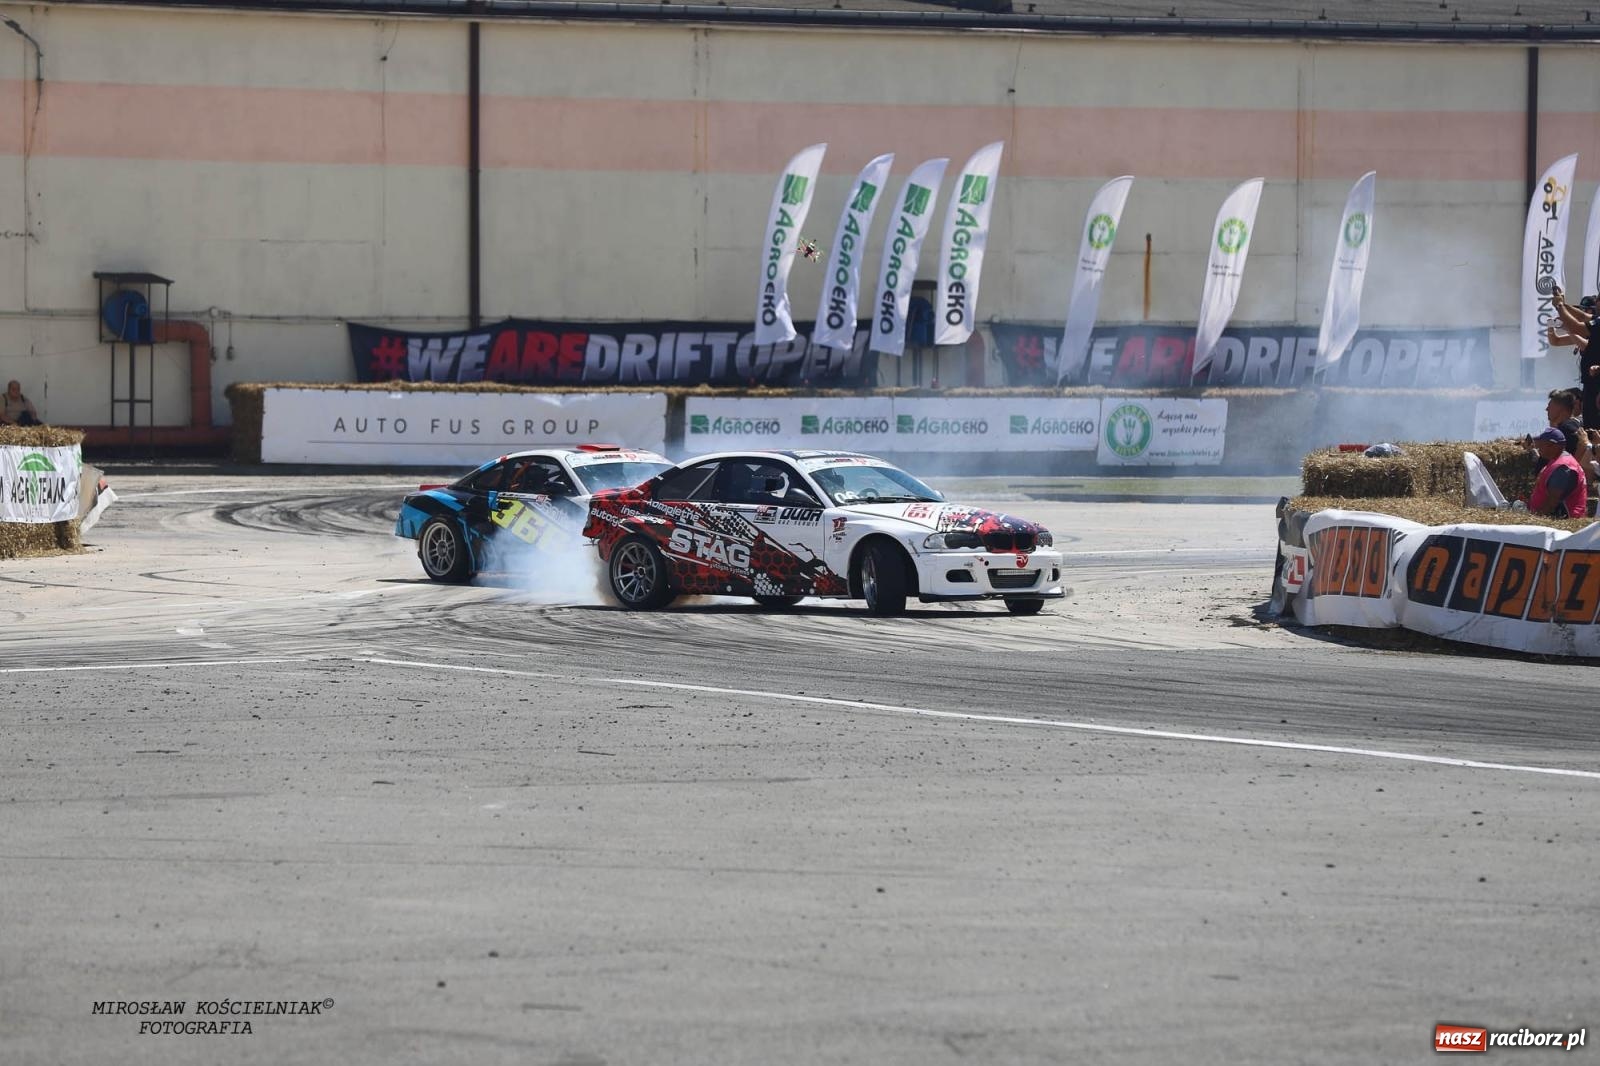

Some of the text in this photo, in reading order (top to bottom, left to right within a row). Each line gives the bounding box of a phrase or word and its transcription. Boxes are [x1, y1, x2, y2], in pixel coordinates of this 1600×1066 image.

[762, 207, 795, 327] AGROEKO
[826, 213, 860, 330] AGROEKO
[879, 216, 916, 335] AGROEKO
[946, 207, 980, 327] AGROEKO
[333, 416, 601, 436] AUTO FUS GROUP
[711, 416, 781, 435] AGROEKO
[821, 416, 889, 435] AGROEKO
[916, 416, 988, 435] AGROEKO
[1030, 416, 1094, 435] AGROEKO
[779, 507, 824, 522] DUDA
[669, 527, 751, 568] STAG
